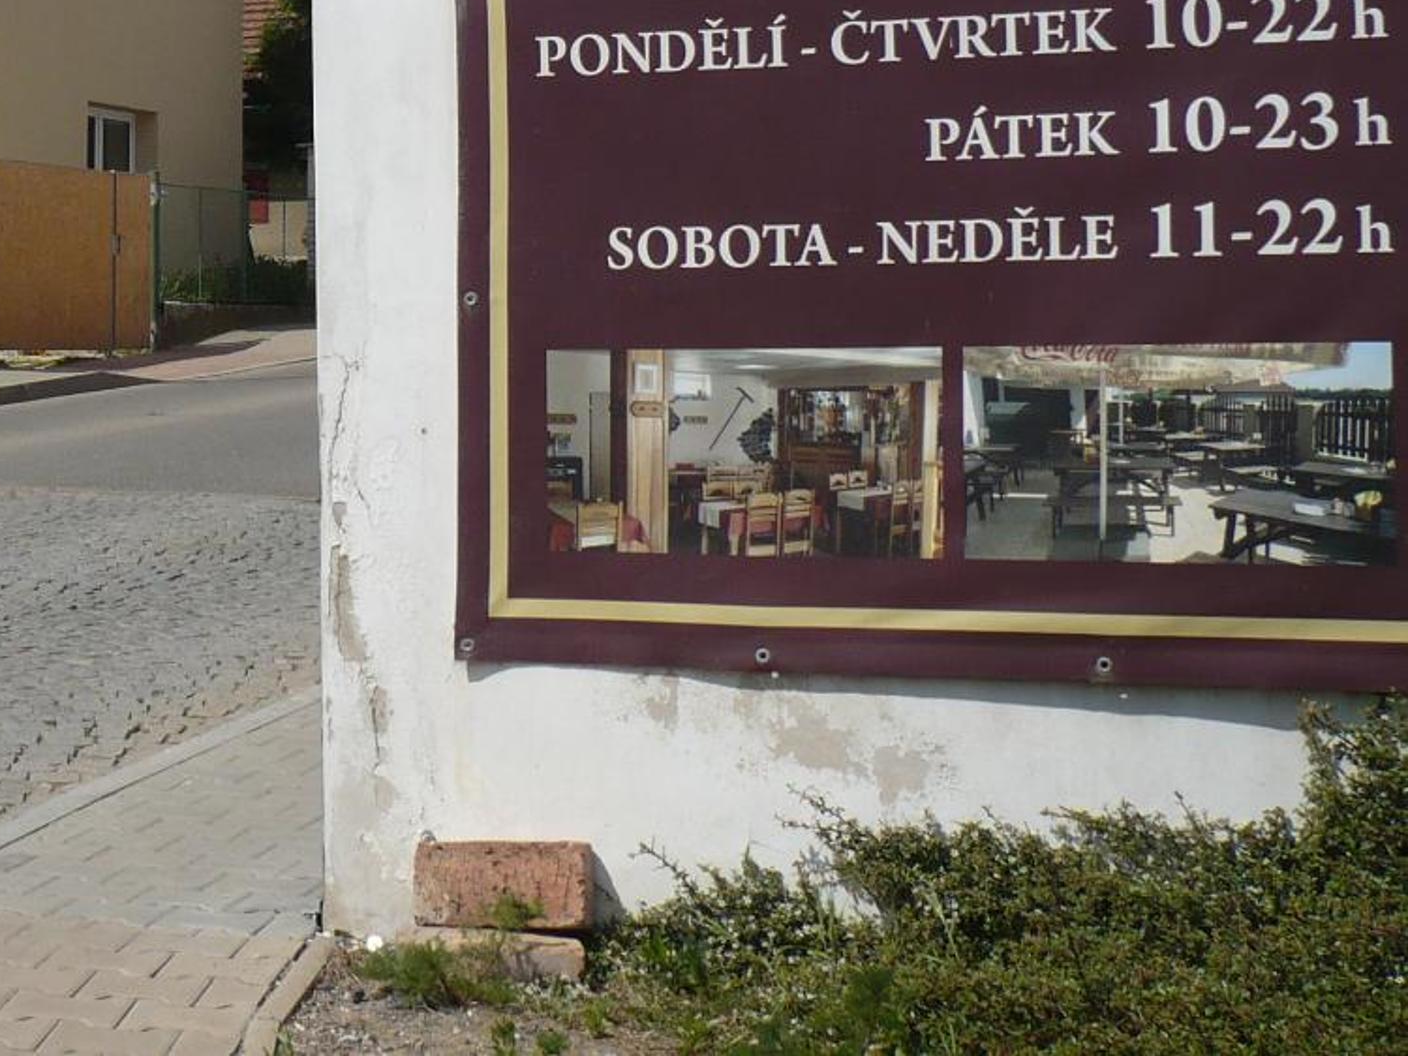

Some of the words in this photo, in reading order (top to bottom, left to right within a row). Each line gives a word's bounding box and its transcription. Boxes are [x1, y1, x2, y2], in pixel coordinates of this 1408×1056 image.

[534, 13, 789, 78] PONDĚLÍ
[830, 6, 1118, 65] ČTVRTEK
[924, 104, 1120, 163] PÁTEK
[1148, 90, 1340, 154] 10-23
[1352, 96, 1392, 147] h
[606, 222, 839, 271] SOBOTA
[875, 206, 1119, 266] NEDĚLE
[1148, 197, 1344, 259] 11-22
[1354, 203, 1395, 254] h
